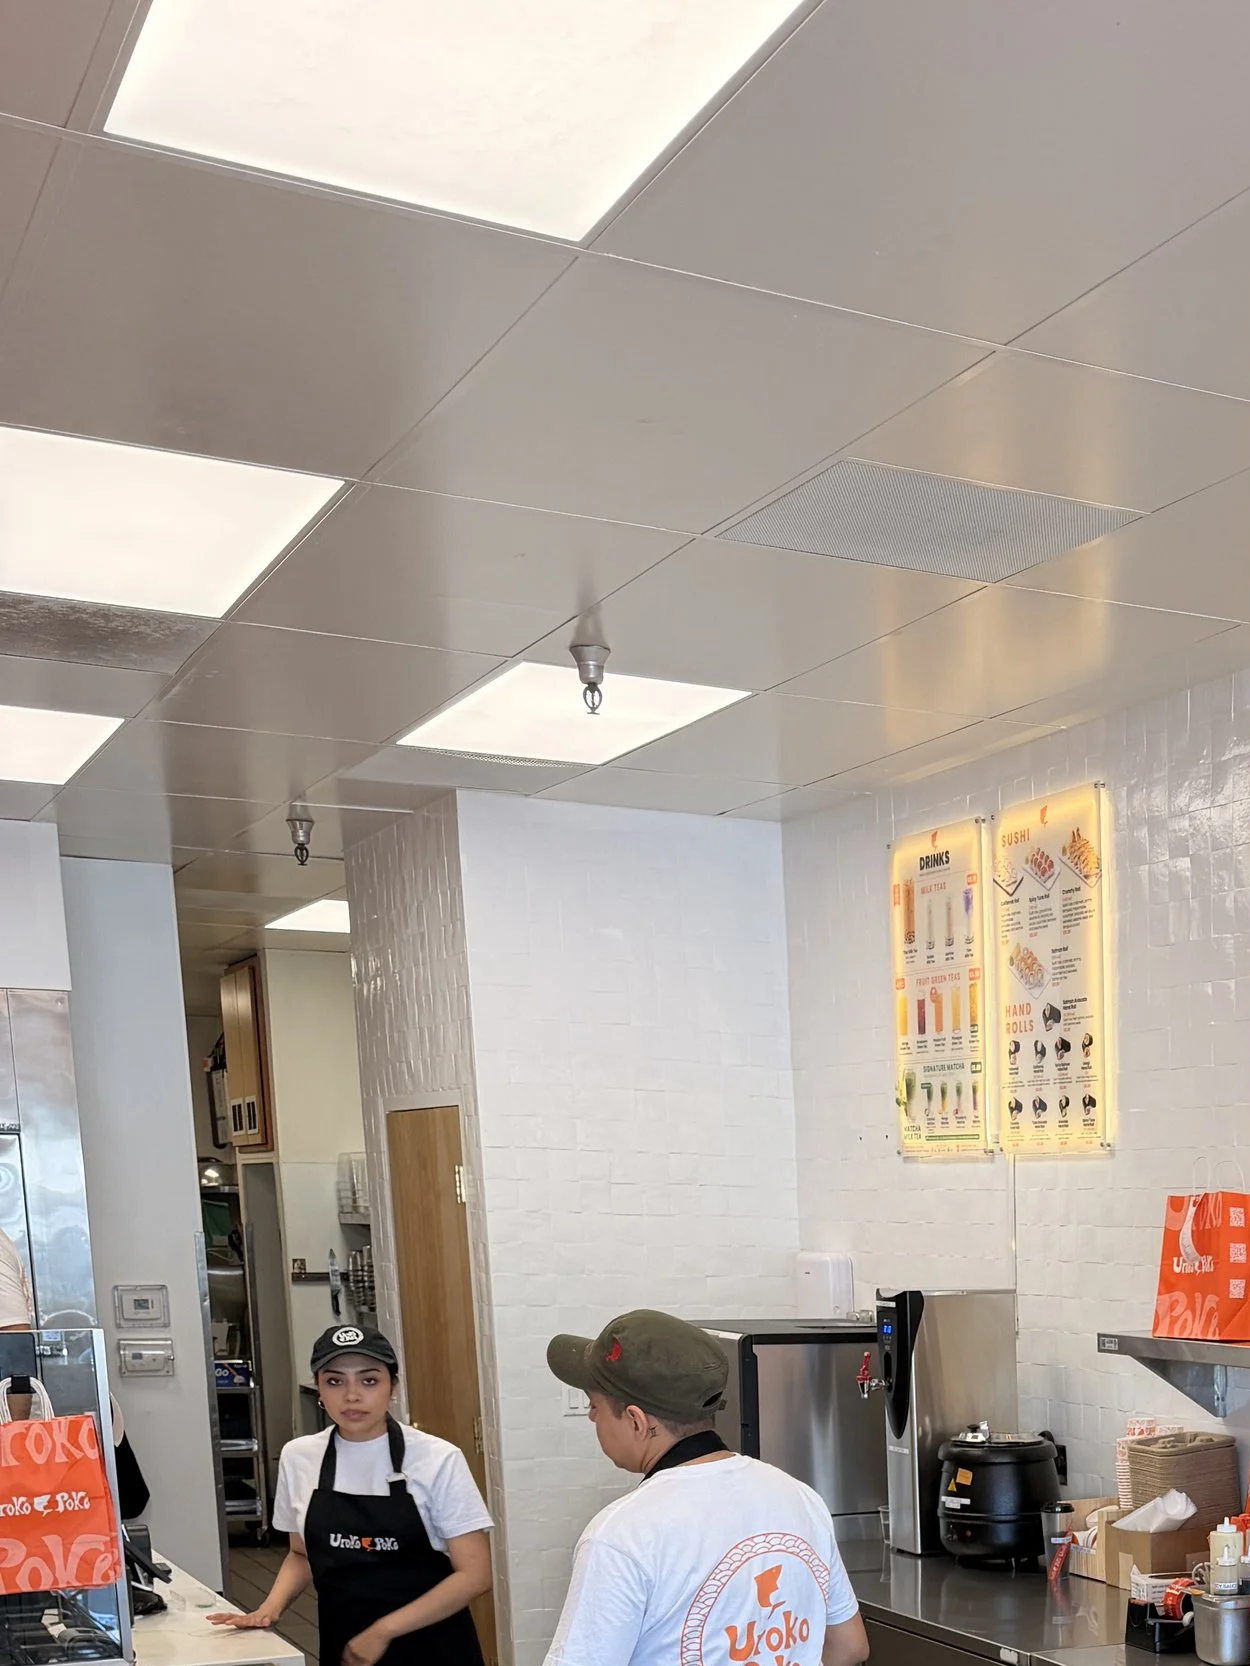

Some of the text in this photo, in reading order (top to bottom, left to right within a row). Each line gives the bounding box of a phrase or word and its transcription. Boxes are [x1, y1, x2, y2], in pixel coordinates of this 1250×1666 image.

[1001, 828, 1031, 848] SUSHI
[919, 850, 950, 871] DRINKS
[1005, 1002, 1032, 1018] HAND
[1005, 1019, 1034, 1035] ROLLS
[724, 1611, 810, 1662] Uroko
